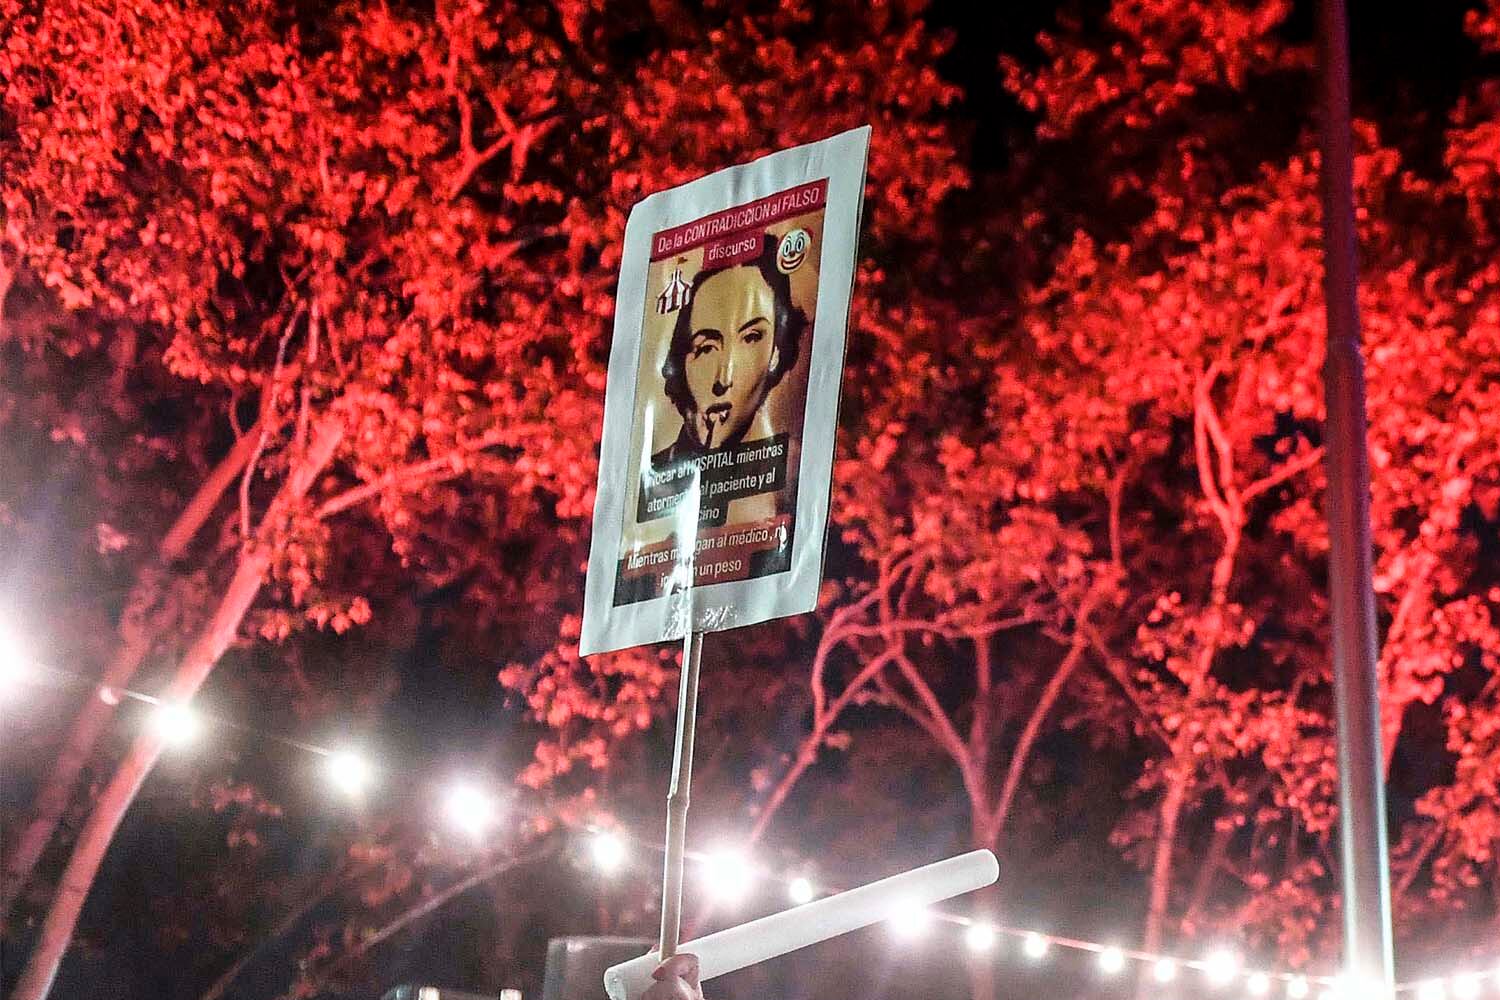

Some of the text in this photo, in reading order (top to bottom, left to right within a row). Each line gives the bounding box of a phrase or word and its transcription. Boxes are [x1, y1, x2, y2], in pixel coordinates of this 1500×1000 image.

[658, 237, 672, 253] De
[673, 233, 683, 246] la
[771, 201, 781, 216] al
[782, 187, 819, 210] FALSO
[708, 237, 757, 261] discurso
[737, 443, 784, 464] mientras
[709, 474, 756, 498] paciente
[758, 474, 764, 490] y
[766, 467, 776, 484] al
[717, 532, 727, 547] al
[700, 562, 713, 577] un
[714, 557, 742, 578] peso
